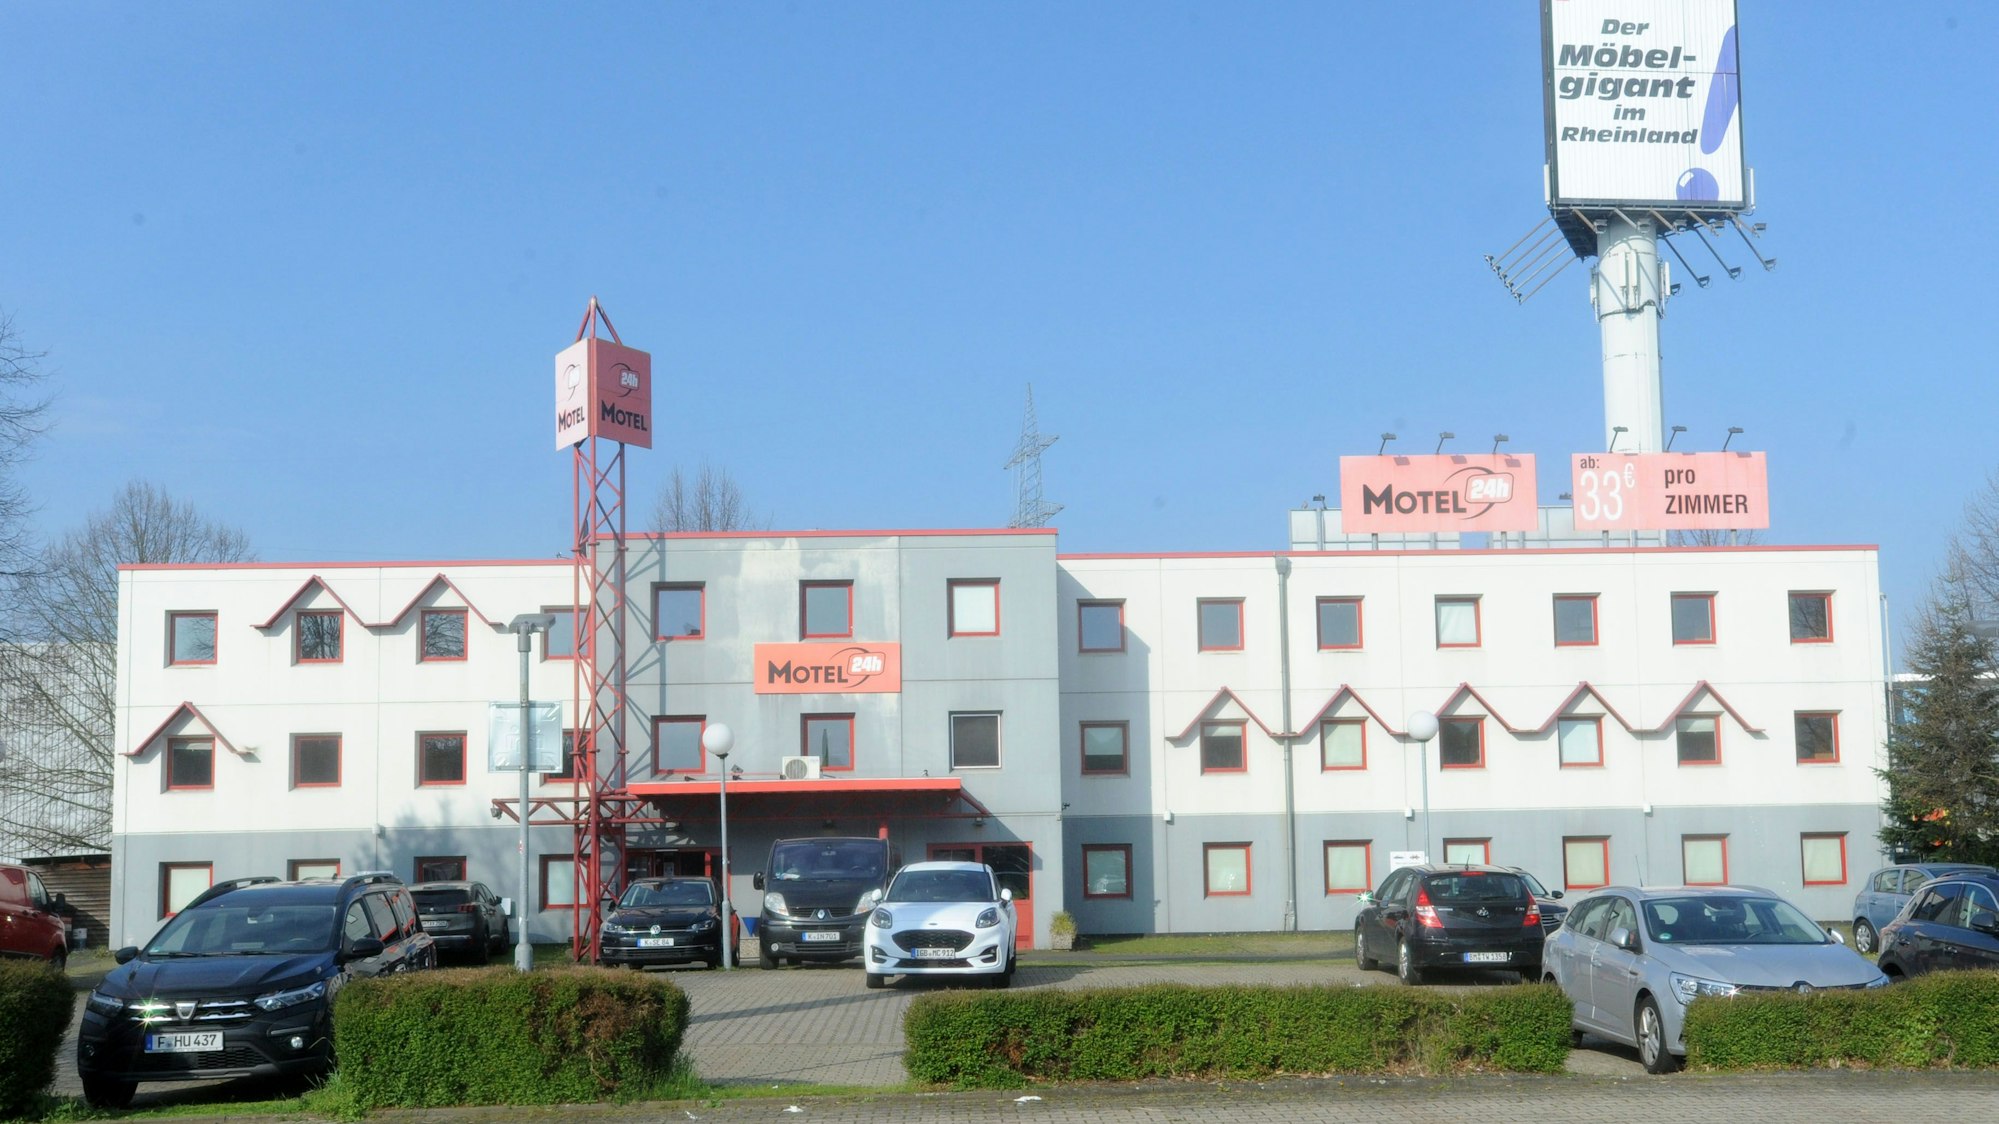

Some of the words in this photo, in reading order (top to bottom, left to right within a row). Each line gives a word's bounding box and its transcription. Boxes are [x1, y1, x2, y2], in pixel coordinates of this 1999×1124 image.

[1601, 19, 1649, 35] Der
[1558, 43, 1697, 69] Möbel-
[1558, 72, 1695, 101] gigant
[1613, 104, 1646, 121] im
[1561, 126, 1698, 144] Rheinland
[620, 371, 638, 389] 24h
[601, 400, 647, 431] MOTEL
[1580, 456, 1600, 469] ab:
[1664, 469, 1696, 488] pro
[1363, 483, 1466, 515] MOTEL
[1470, 478, 1509, 500] 24h
[1665, 494, 1748, 514] ZIMMER
[768, 660, 848, 684] MOTEL
[851, 656, 882, 673] 24h
[193, 1034, 217, 1047] 437
